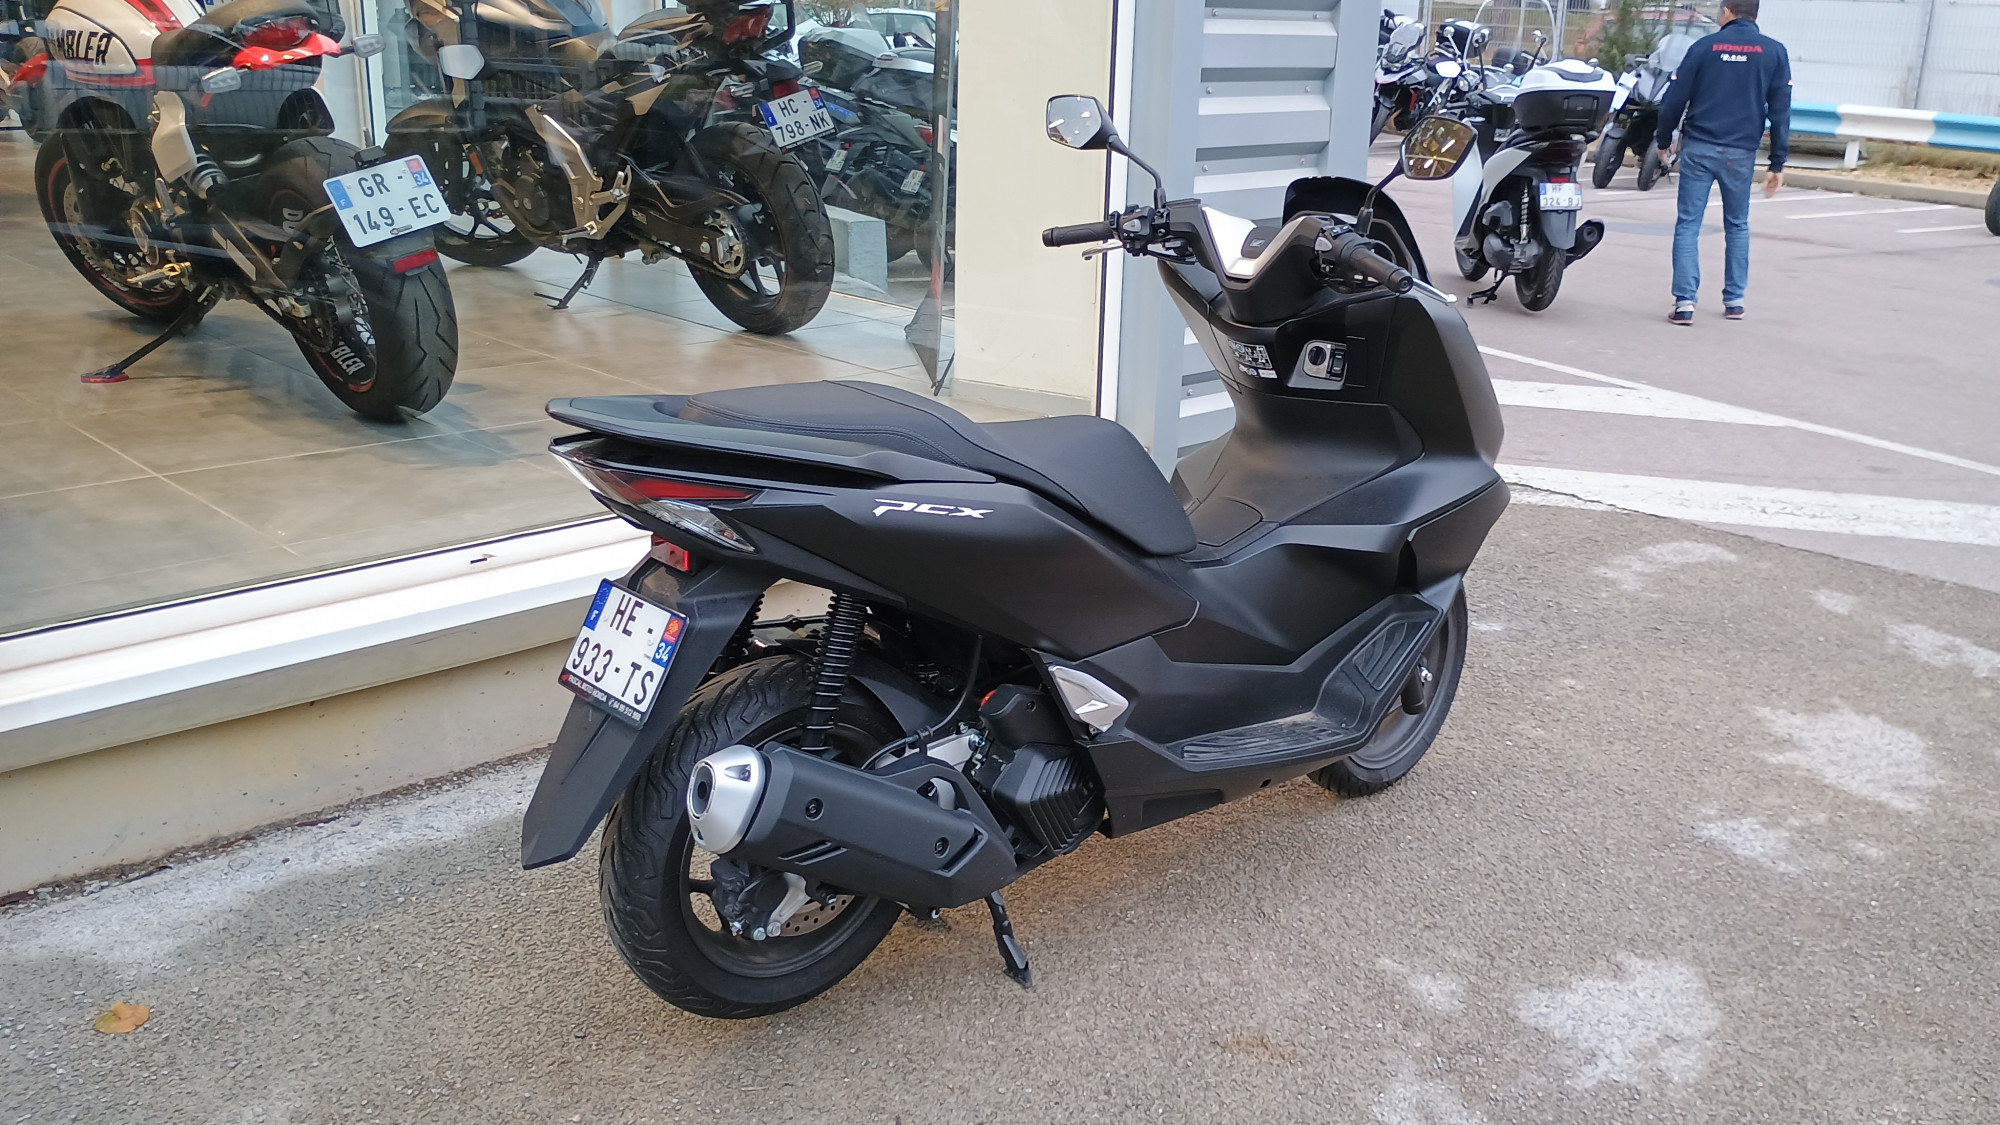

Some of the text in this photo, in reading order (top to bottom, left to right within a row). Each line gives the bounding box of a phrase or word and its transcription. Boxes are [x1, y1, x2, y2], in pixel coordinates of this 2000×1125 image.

[1712, 43, 1763, 53] HONDA
[815, 99, 824, 109] 34
[775, 112, 830, 143] 798-NK
[413, 170, 430, 186] 34
[340, 199, 346, 207] F
[352, 193, 440, 235] 149-EC
[872, 498, 994, 518] PCX
[590, 610, 599, 621] F
[655, 642, 672, 663] 34
[571, 636, 655, 706] 933-TS
